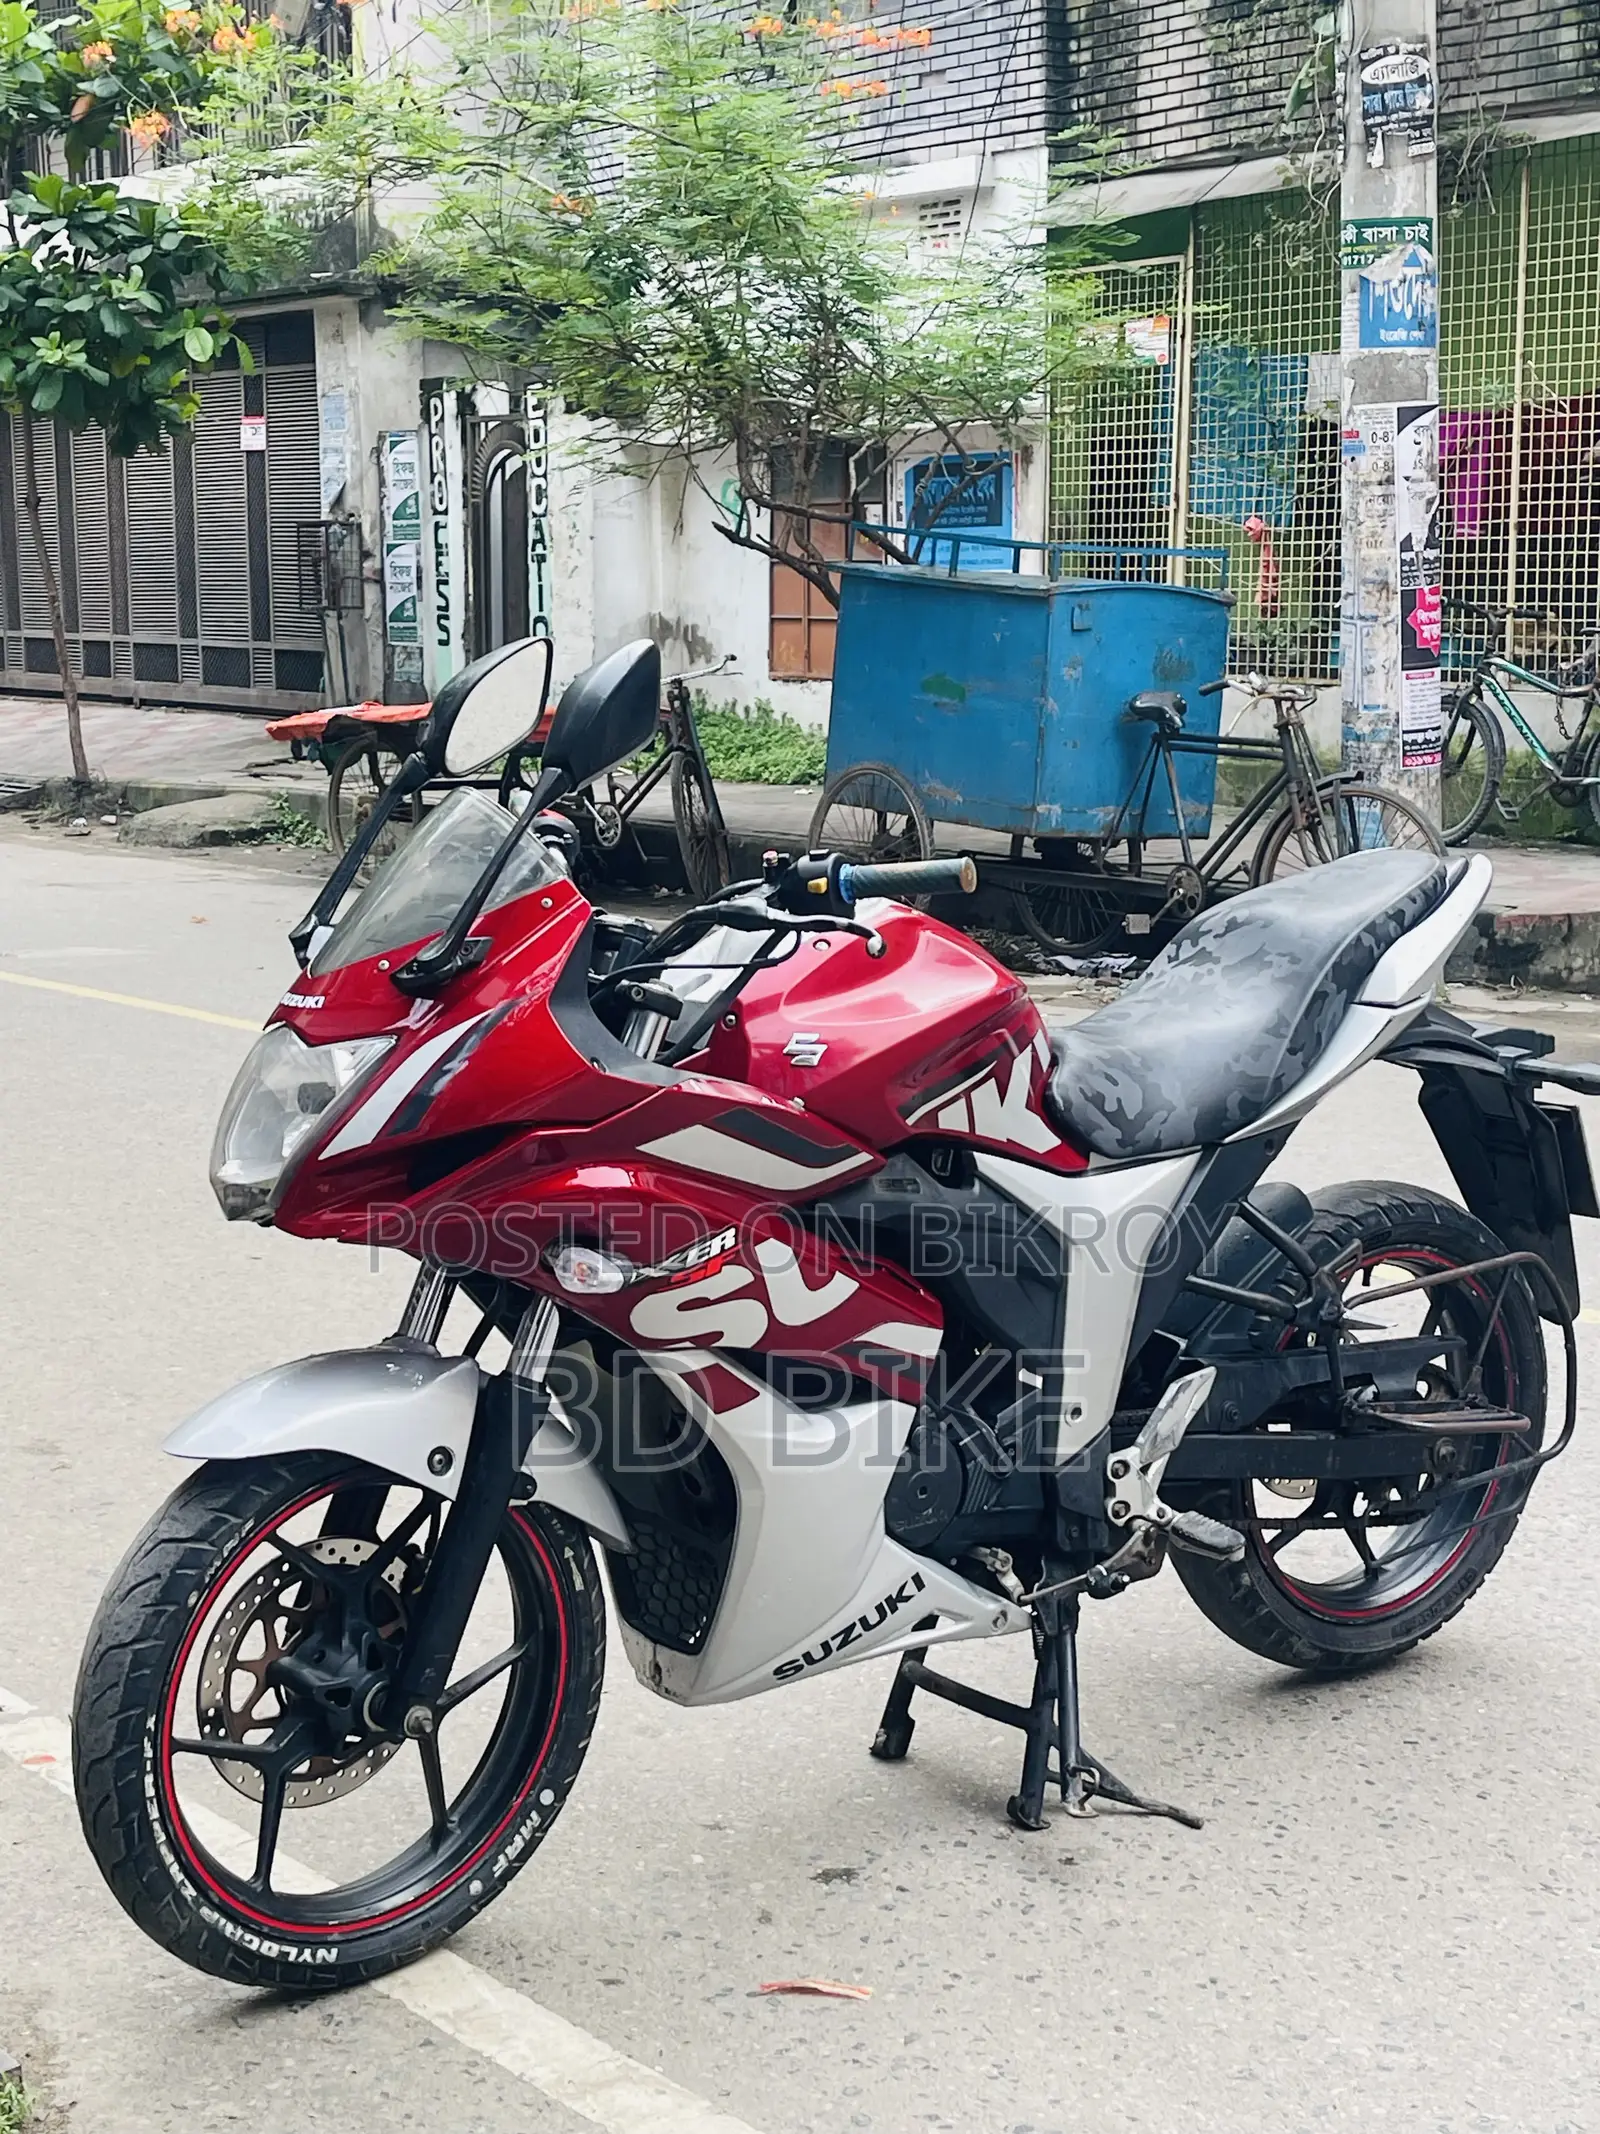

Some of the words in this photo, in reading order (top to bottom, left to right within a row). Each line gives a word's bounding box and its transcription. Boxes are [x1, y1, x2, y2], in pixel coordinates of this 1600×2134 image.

[1361, 226, 1398, 243] বাসা
[1403, 221, 1430, 242] চাই
[428, 396, 451, 647] PROCESS
[772, 1571, 927, 1681] SUZUKI
[492, 1809, 542, 1878] MRF
[199, 1904, 339, 1965] NYLOGRIP
